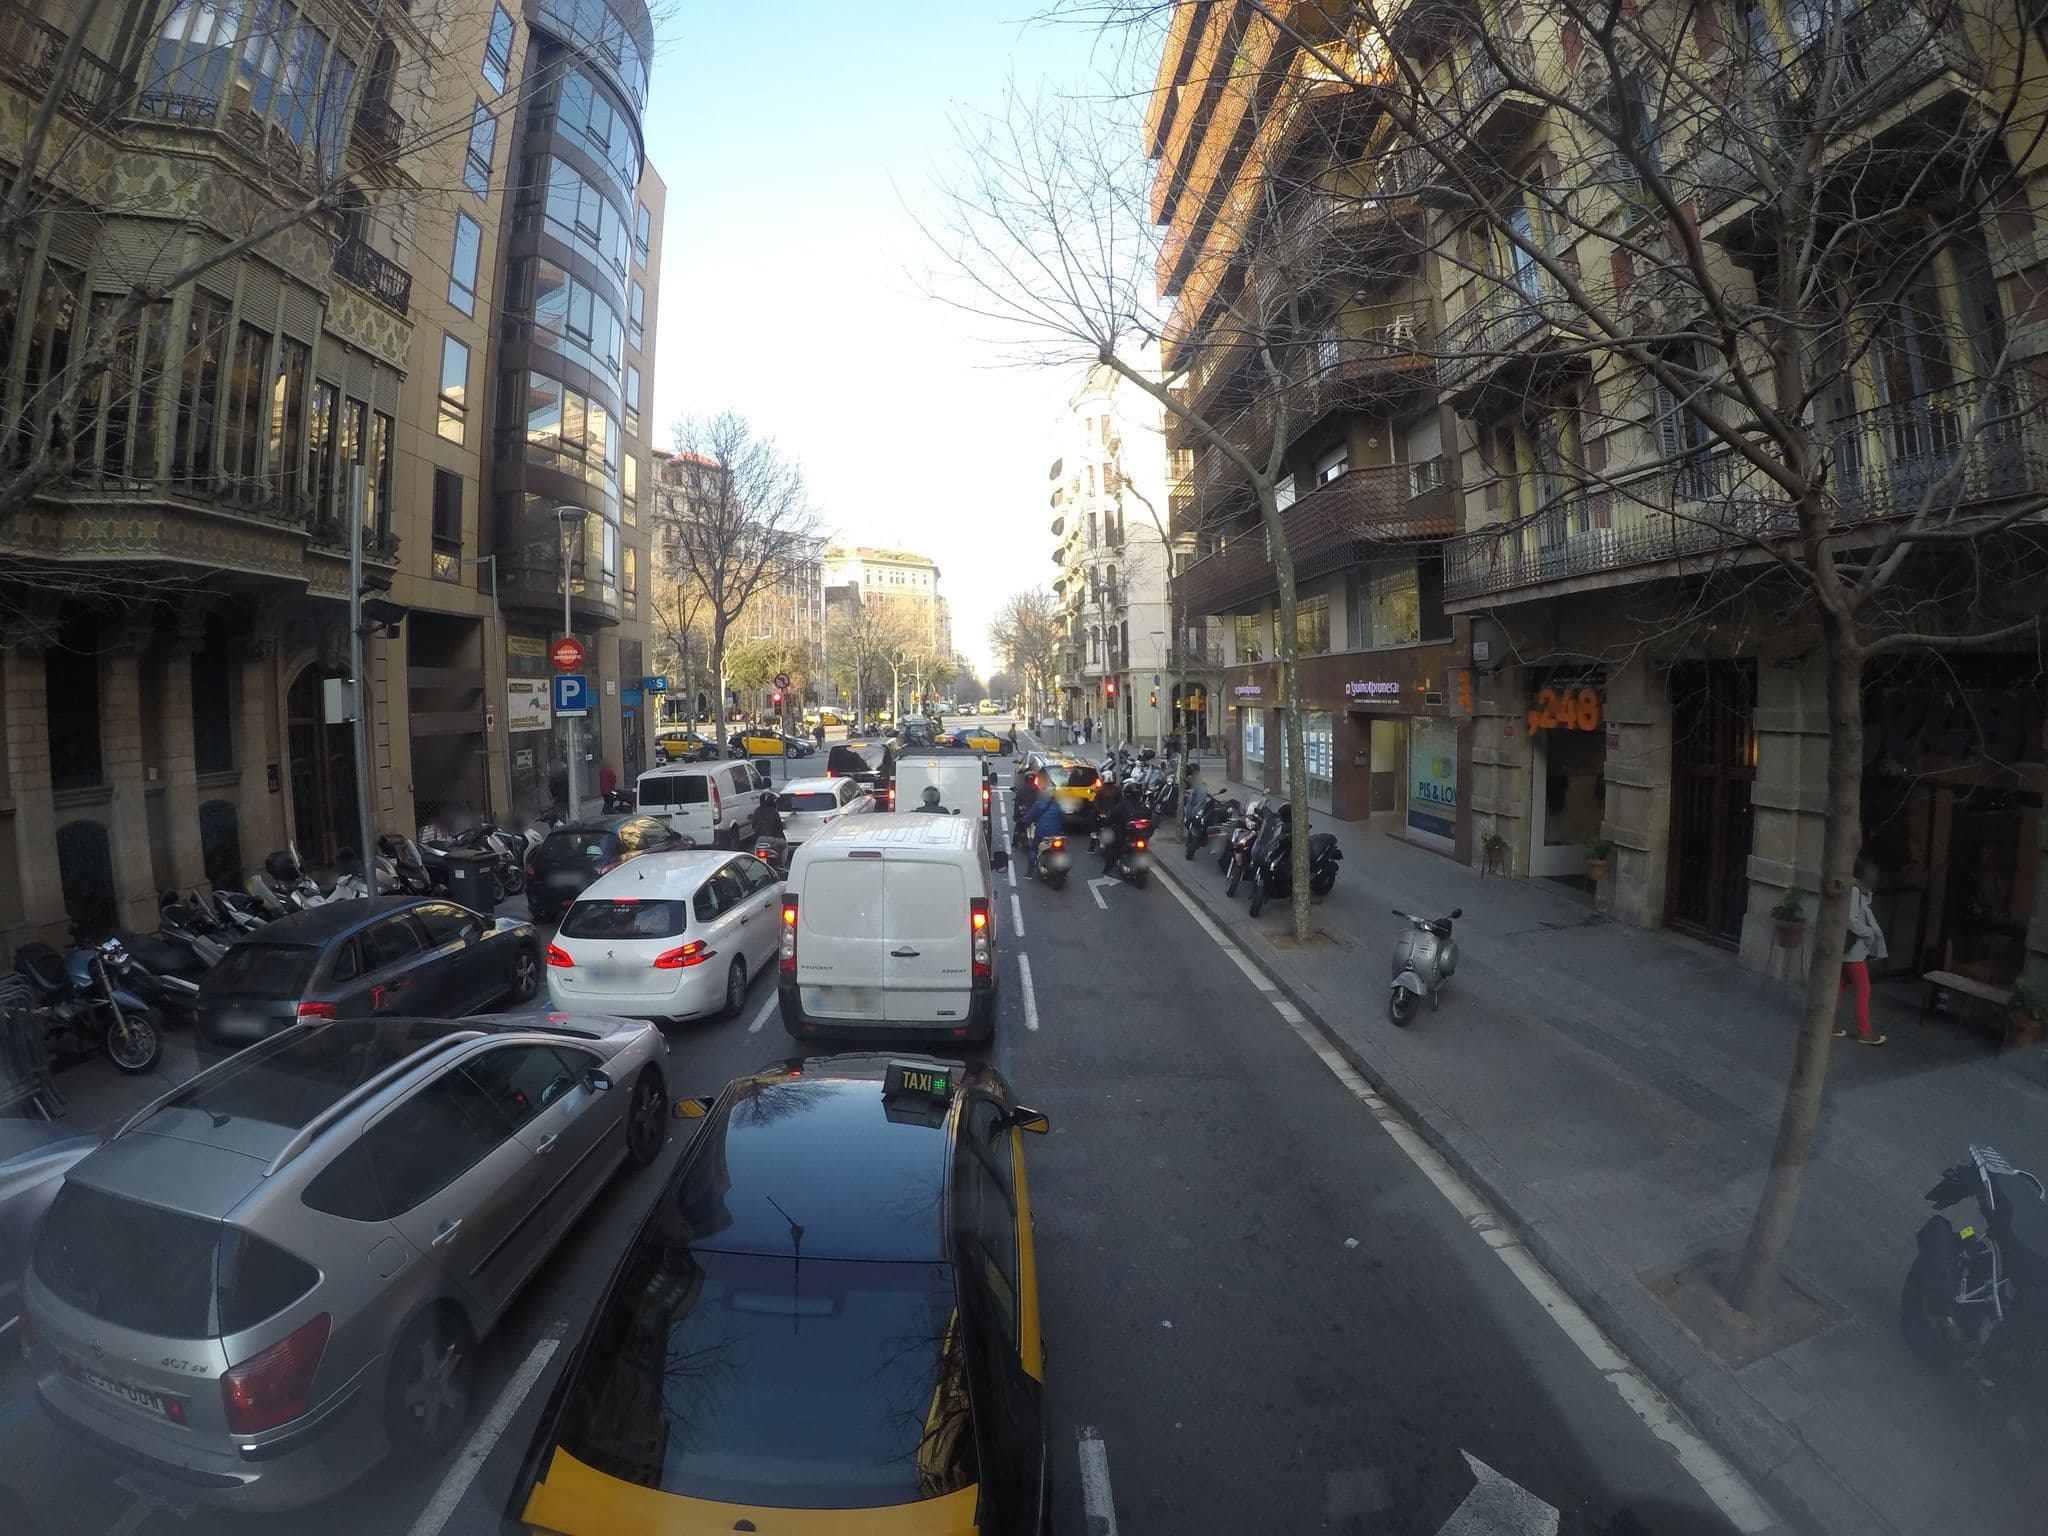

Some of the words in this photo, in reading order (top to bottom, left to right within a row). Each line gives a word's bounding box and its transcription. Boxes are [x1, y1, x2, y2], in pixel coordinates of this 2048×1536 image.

[561, 680, 580, 706] P
[1418, 781, 1430, 799] PIS
[1432, 785, 1439, 800] &
[902, 1071, 932, 1092] TAXI
[161, 1357, 189, 1371] 407
